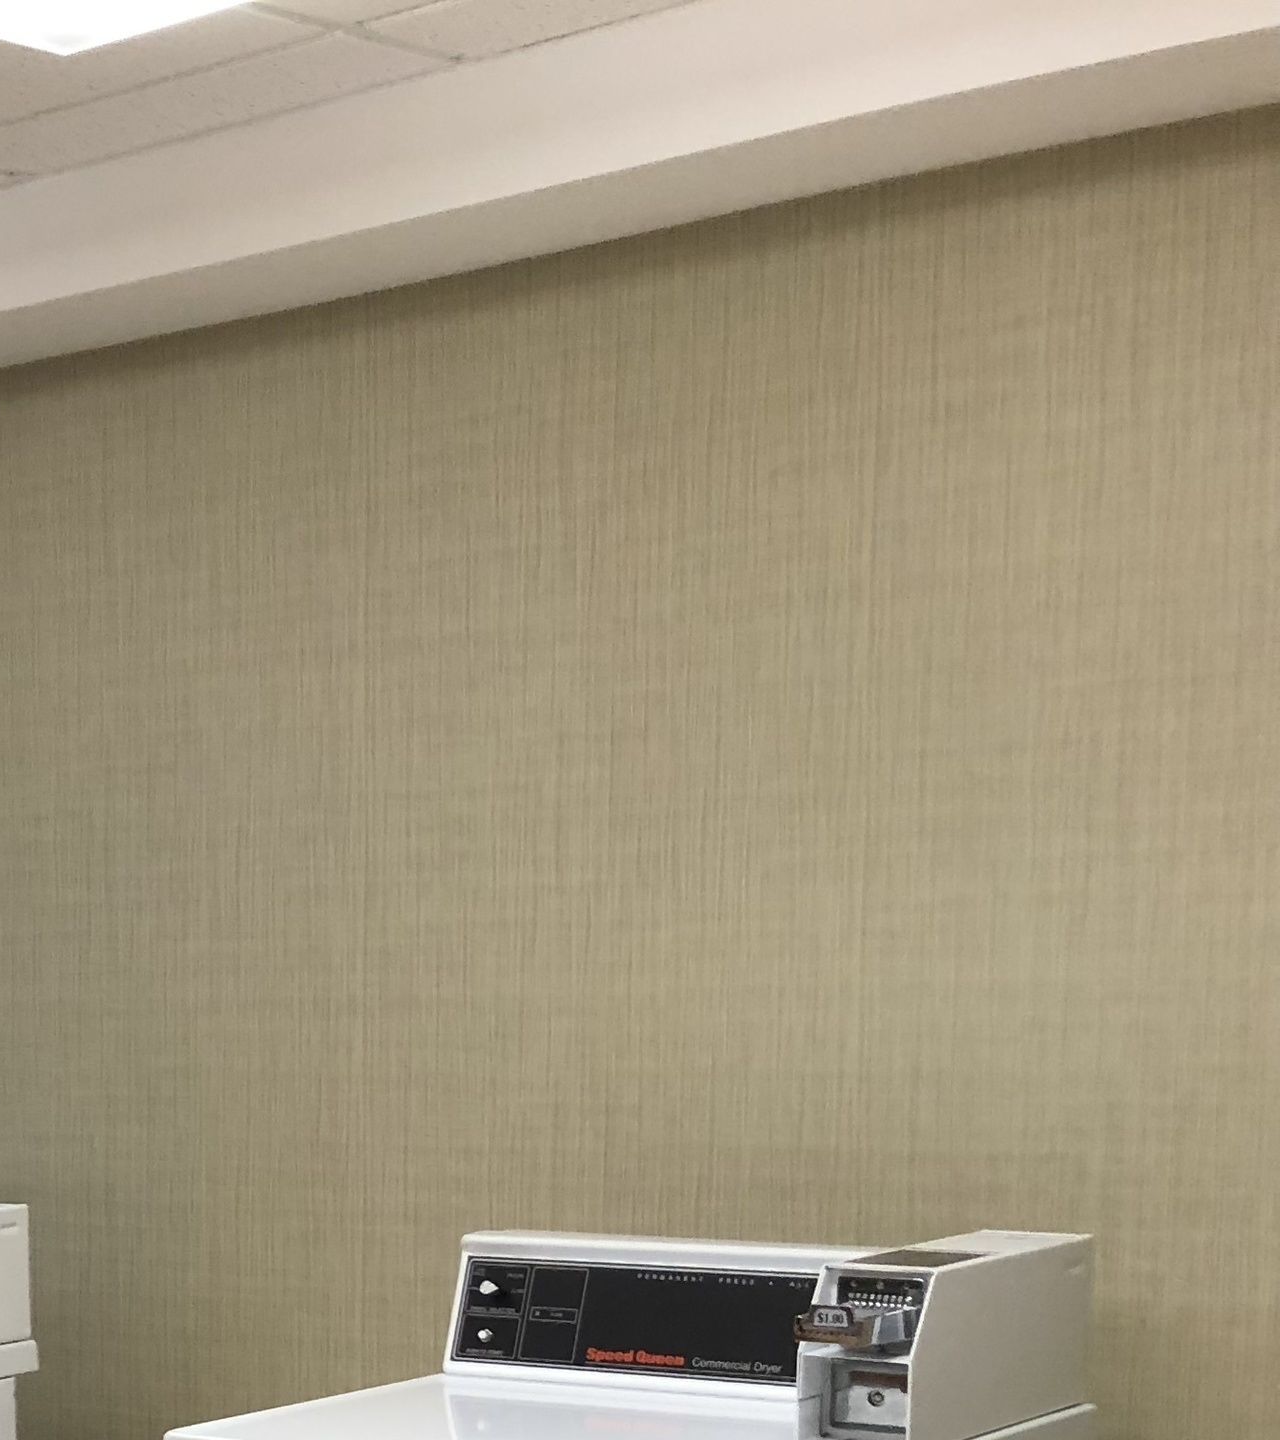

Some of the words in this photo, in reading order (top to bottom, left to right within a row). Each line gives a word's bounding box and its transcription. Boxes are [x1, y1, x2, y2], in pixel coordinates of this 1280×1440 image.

[585, 1347, 634, 1363] Speed
[636, 1350, 685, 1366] Queen
[691, 1356, 752, 1371] Commercial
[753, 1361, 783, 1374] Dryer
